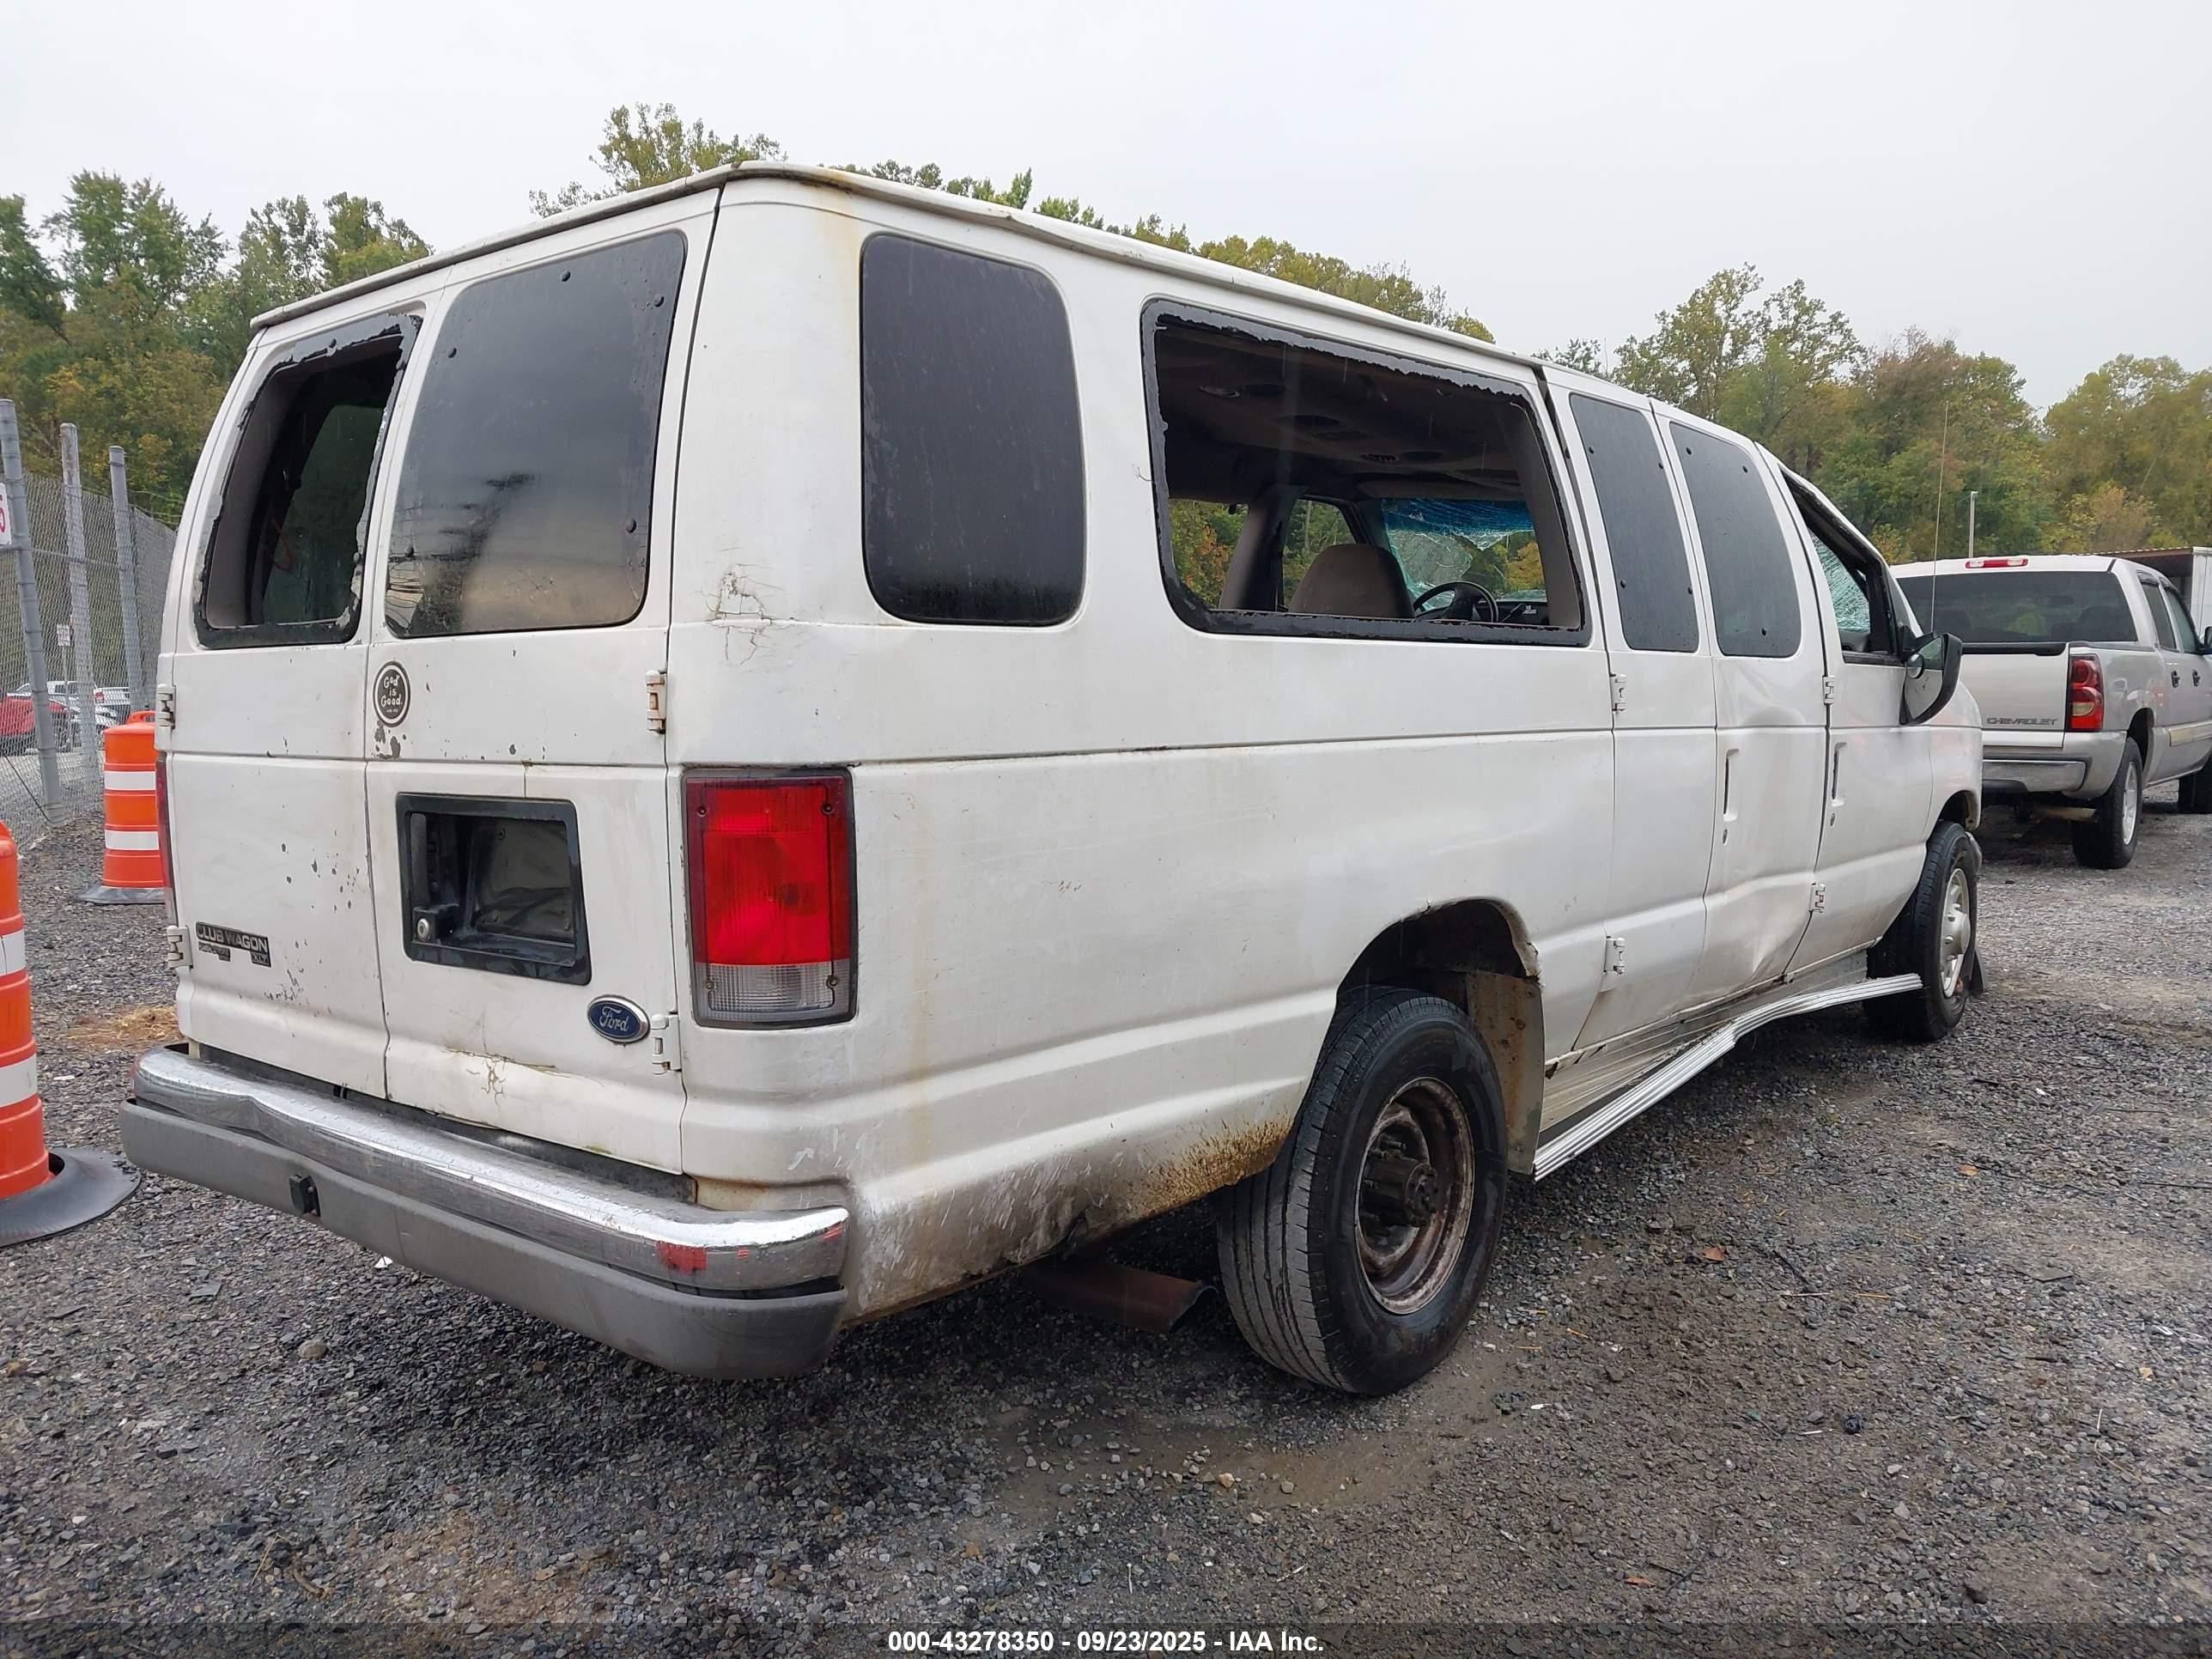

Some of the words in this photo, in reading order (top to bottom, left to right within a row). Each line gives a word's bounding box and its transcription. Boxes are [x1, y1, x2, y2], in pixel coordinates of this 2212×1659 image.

[383, 674, 400, 689] God
[389, 686, 397, 696] is
[1986, 716, 2059, 726] CHEVROLET
[196, 925, 224, 943] CLUB
[225, 931, 268, 953] WAGON
[252, 952, 269, 963] XLT
[599, 1006, 629, 1032] Ford
